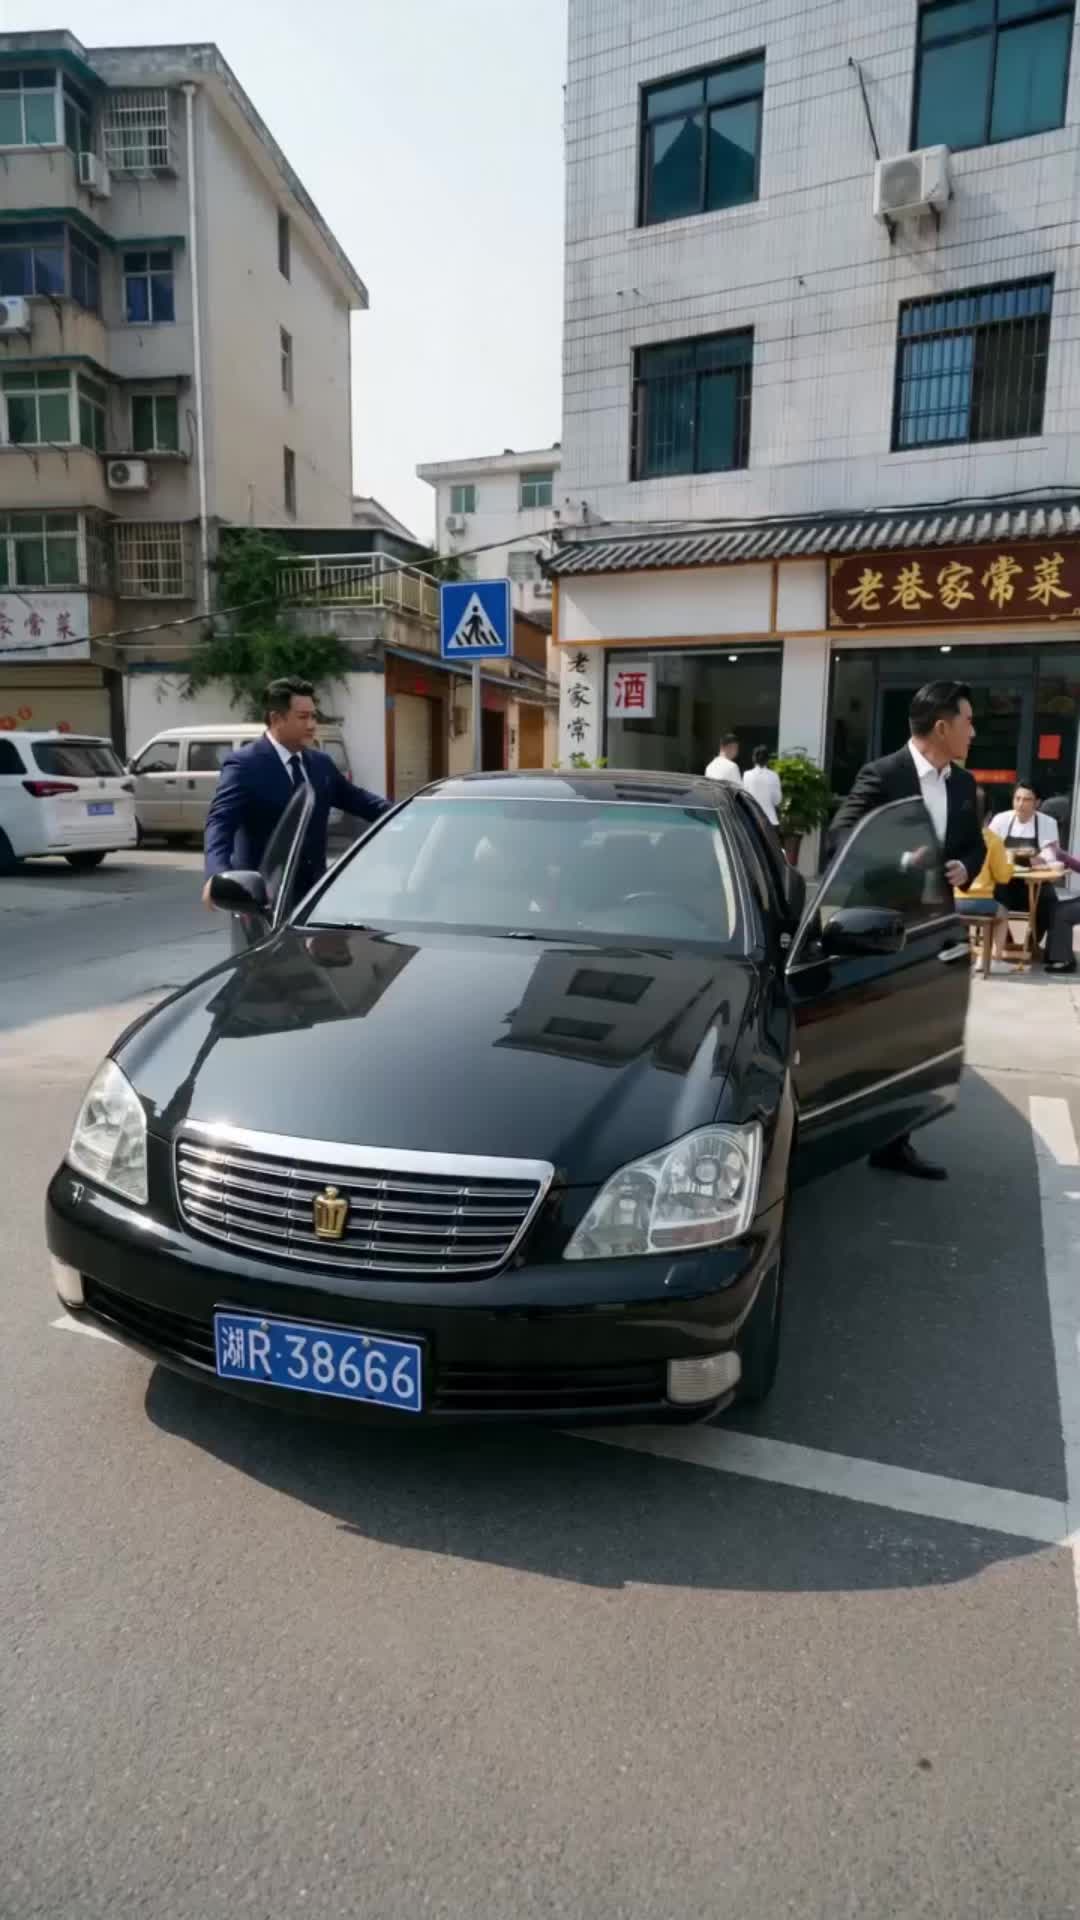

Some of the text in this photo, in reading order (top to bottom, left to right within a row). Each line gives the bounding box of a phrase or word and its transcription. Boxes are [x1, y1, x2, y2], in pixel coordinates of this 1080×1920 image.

[848, 552, 1072, 610] 老巷家常菜
[567, 651, 591, 764] 老家常
[614, 672, 647, 708] 酒
